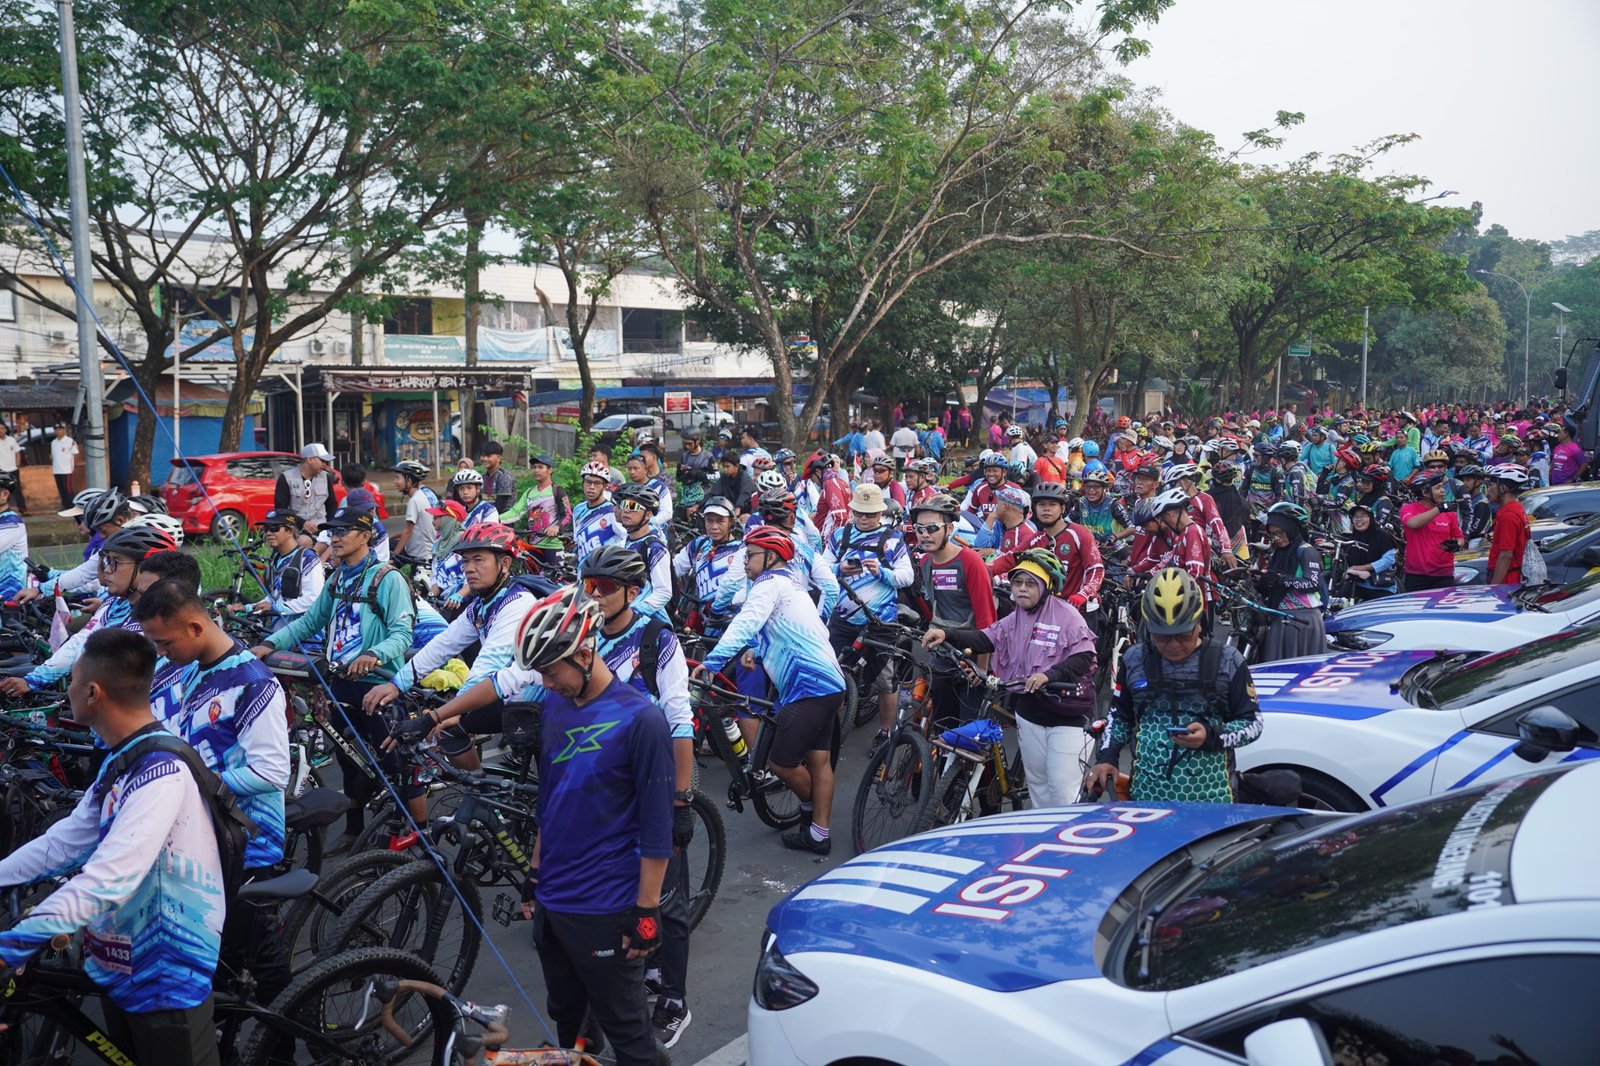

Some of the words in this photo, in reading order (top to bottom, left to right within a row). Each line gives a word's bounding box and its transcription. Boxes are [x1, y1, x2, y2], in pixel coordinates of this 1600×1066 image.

[401, 376, 438, 389] WARKOP
[439, 375, 458, 388] GEN
[458, 376, 467, 387] Z
[930, 806, 1175, 921] POLISI
[104, 947, 130, 961] 1433
